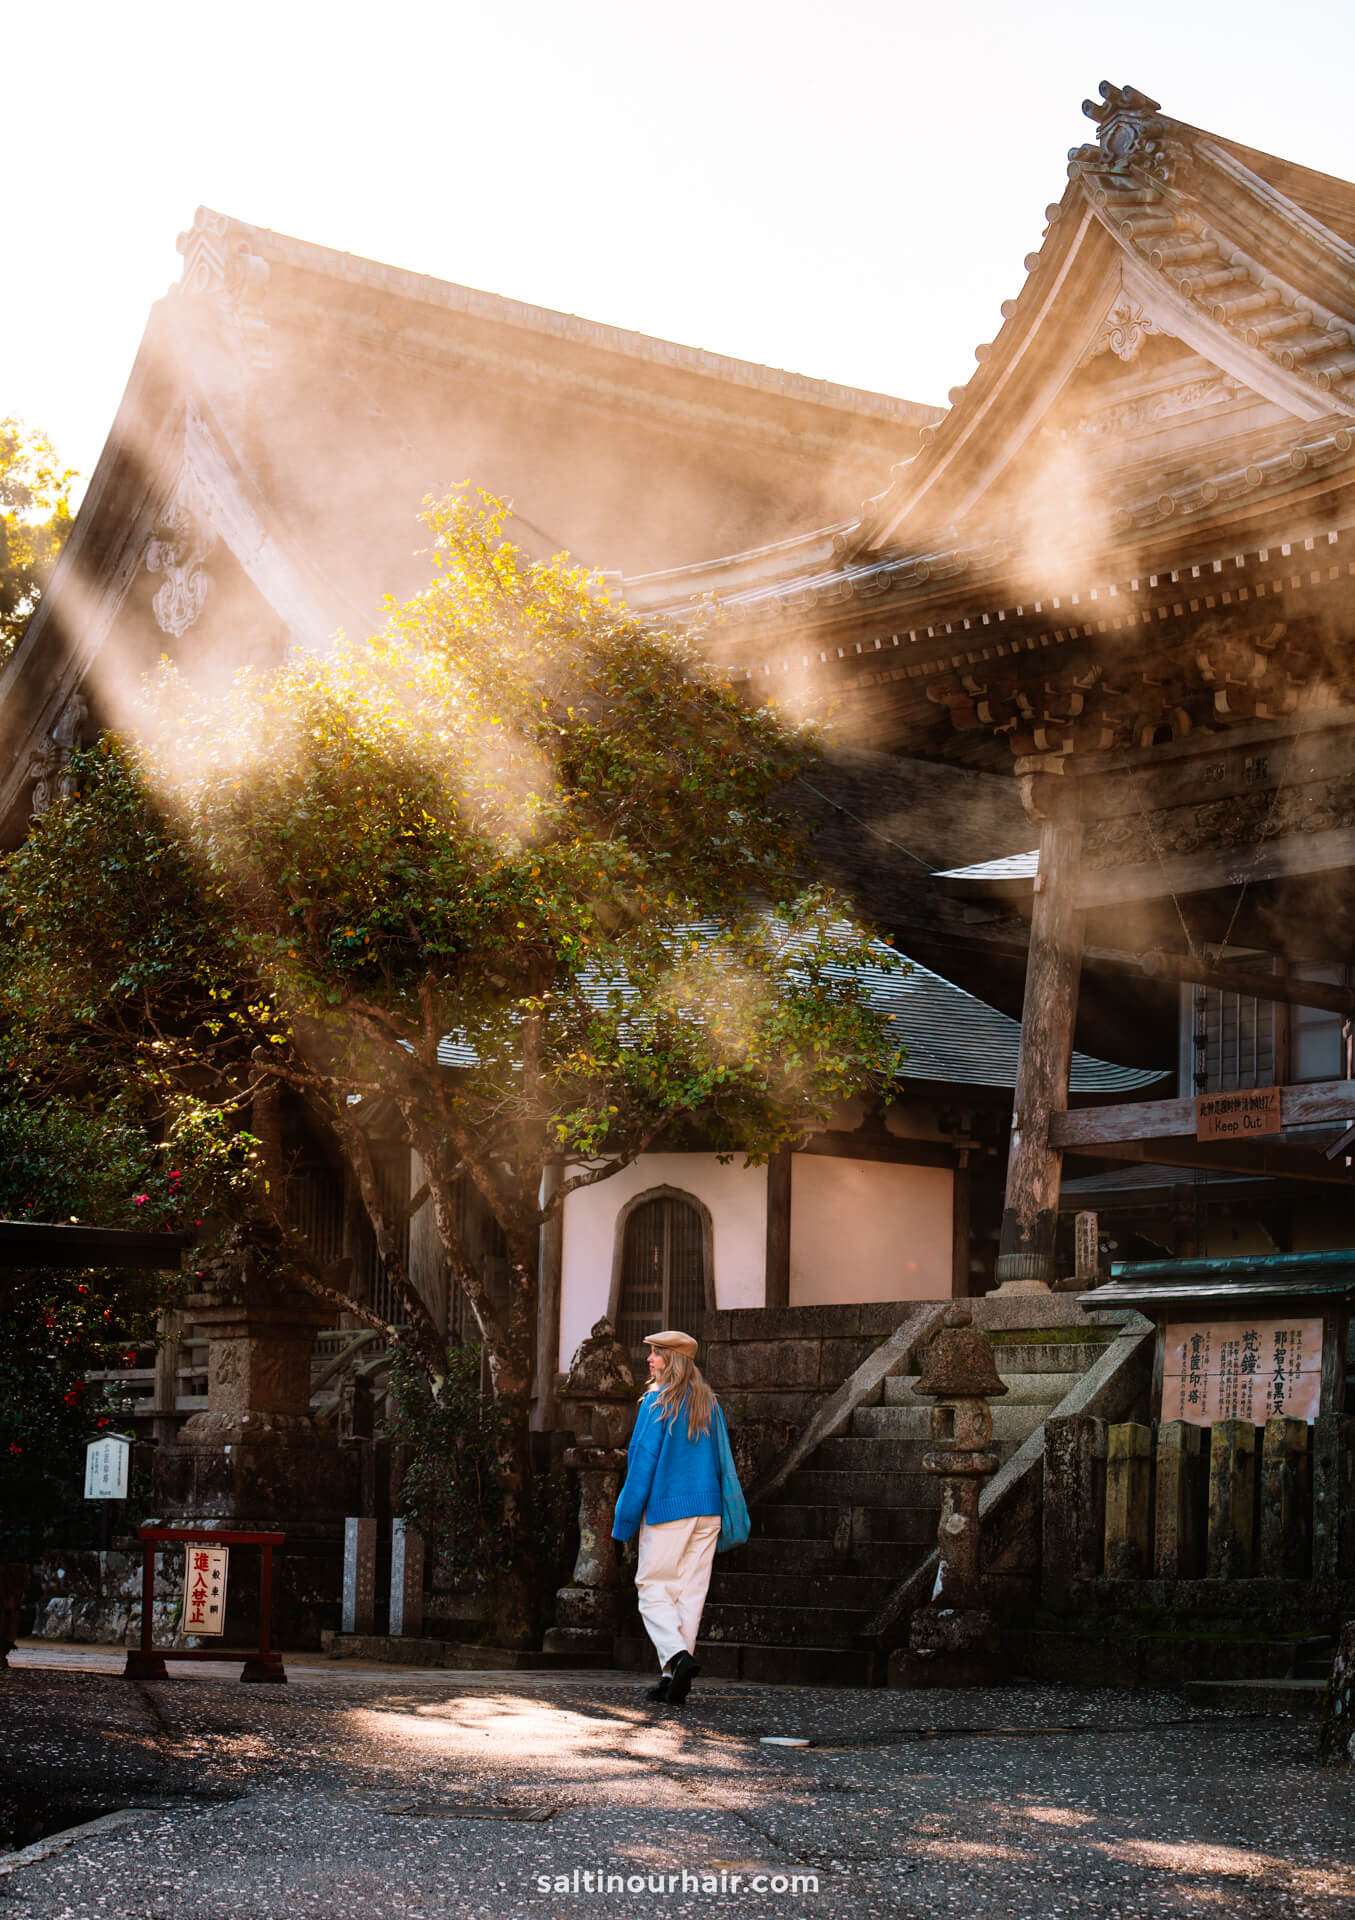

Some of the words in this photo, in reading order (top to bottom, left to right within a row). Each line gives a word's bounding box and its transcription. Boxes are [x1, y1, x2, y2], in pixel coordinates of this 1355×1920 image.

[1215, 1117, 1240, 1134] Keep
[1243, 1114, 1263, 1128] Out
[1241, 1329, 1259, 1375] 梵鐘
[189, 1552, 209, 1624] 進入禁止
